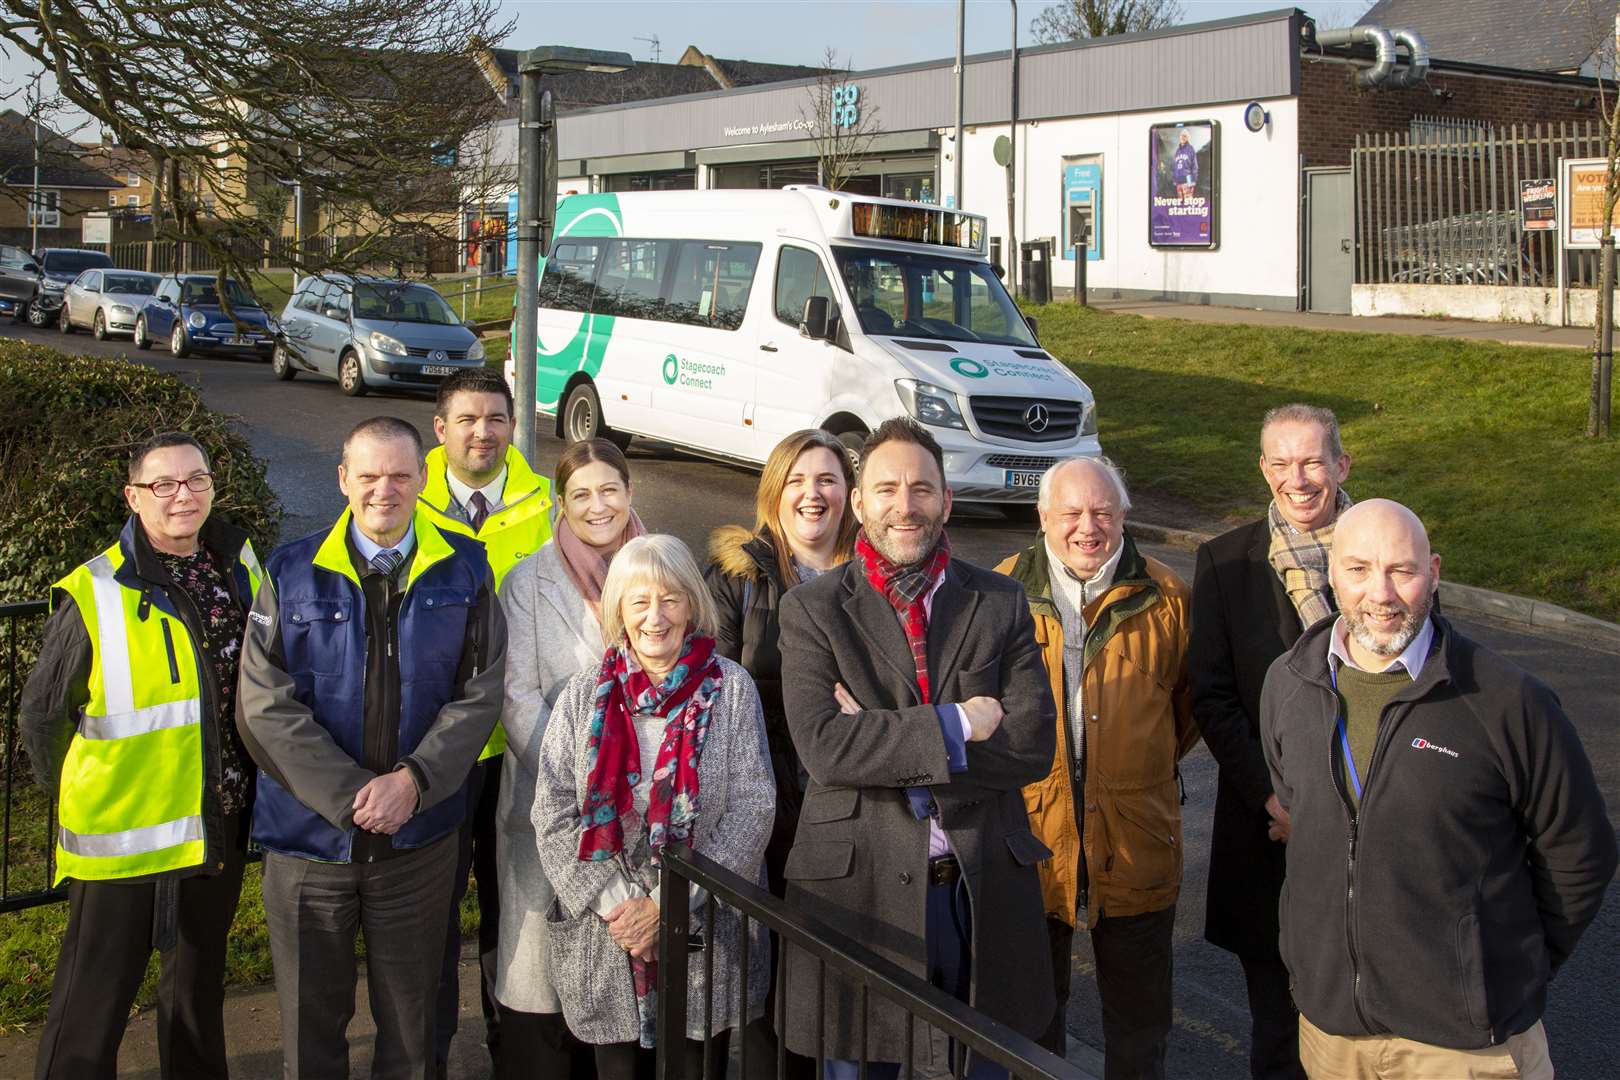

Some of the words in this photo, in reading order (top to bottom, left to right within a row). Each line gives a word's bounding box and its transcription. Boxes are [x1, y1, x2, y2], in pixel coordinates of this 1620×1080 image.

[724, 125, 751, 136] Welcome
[751, 125, 759, 135] to
[760, 121, 793, 136] Aylesham's
[793, 119, 814, 131] Co-op
[1154, 196, 1183, 206] Never
[1183, 196, 1205, 207] stop
[1168, 205, 1209, 217] starting
[681, 358, 726, 376] Stagecoach
[680, 373, 712, 390] Connect
[1013, 472, 1040, 486] BV66
[1426, 742, 1460, 758] berghaus
